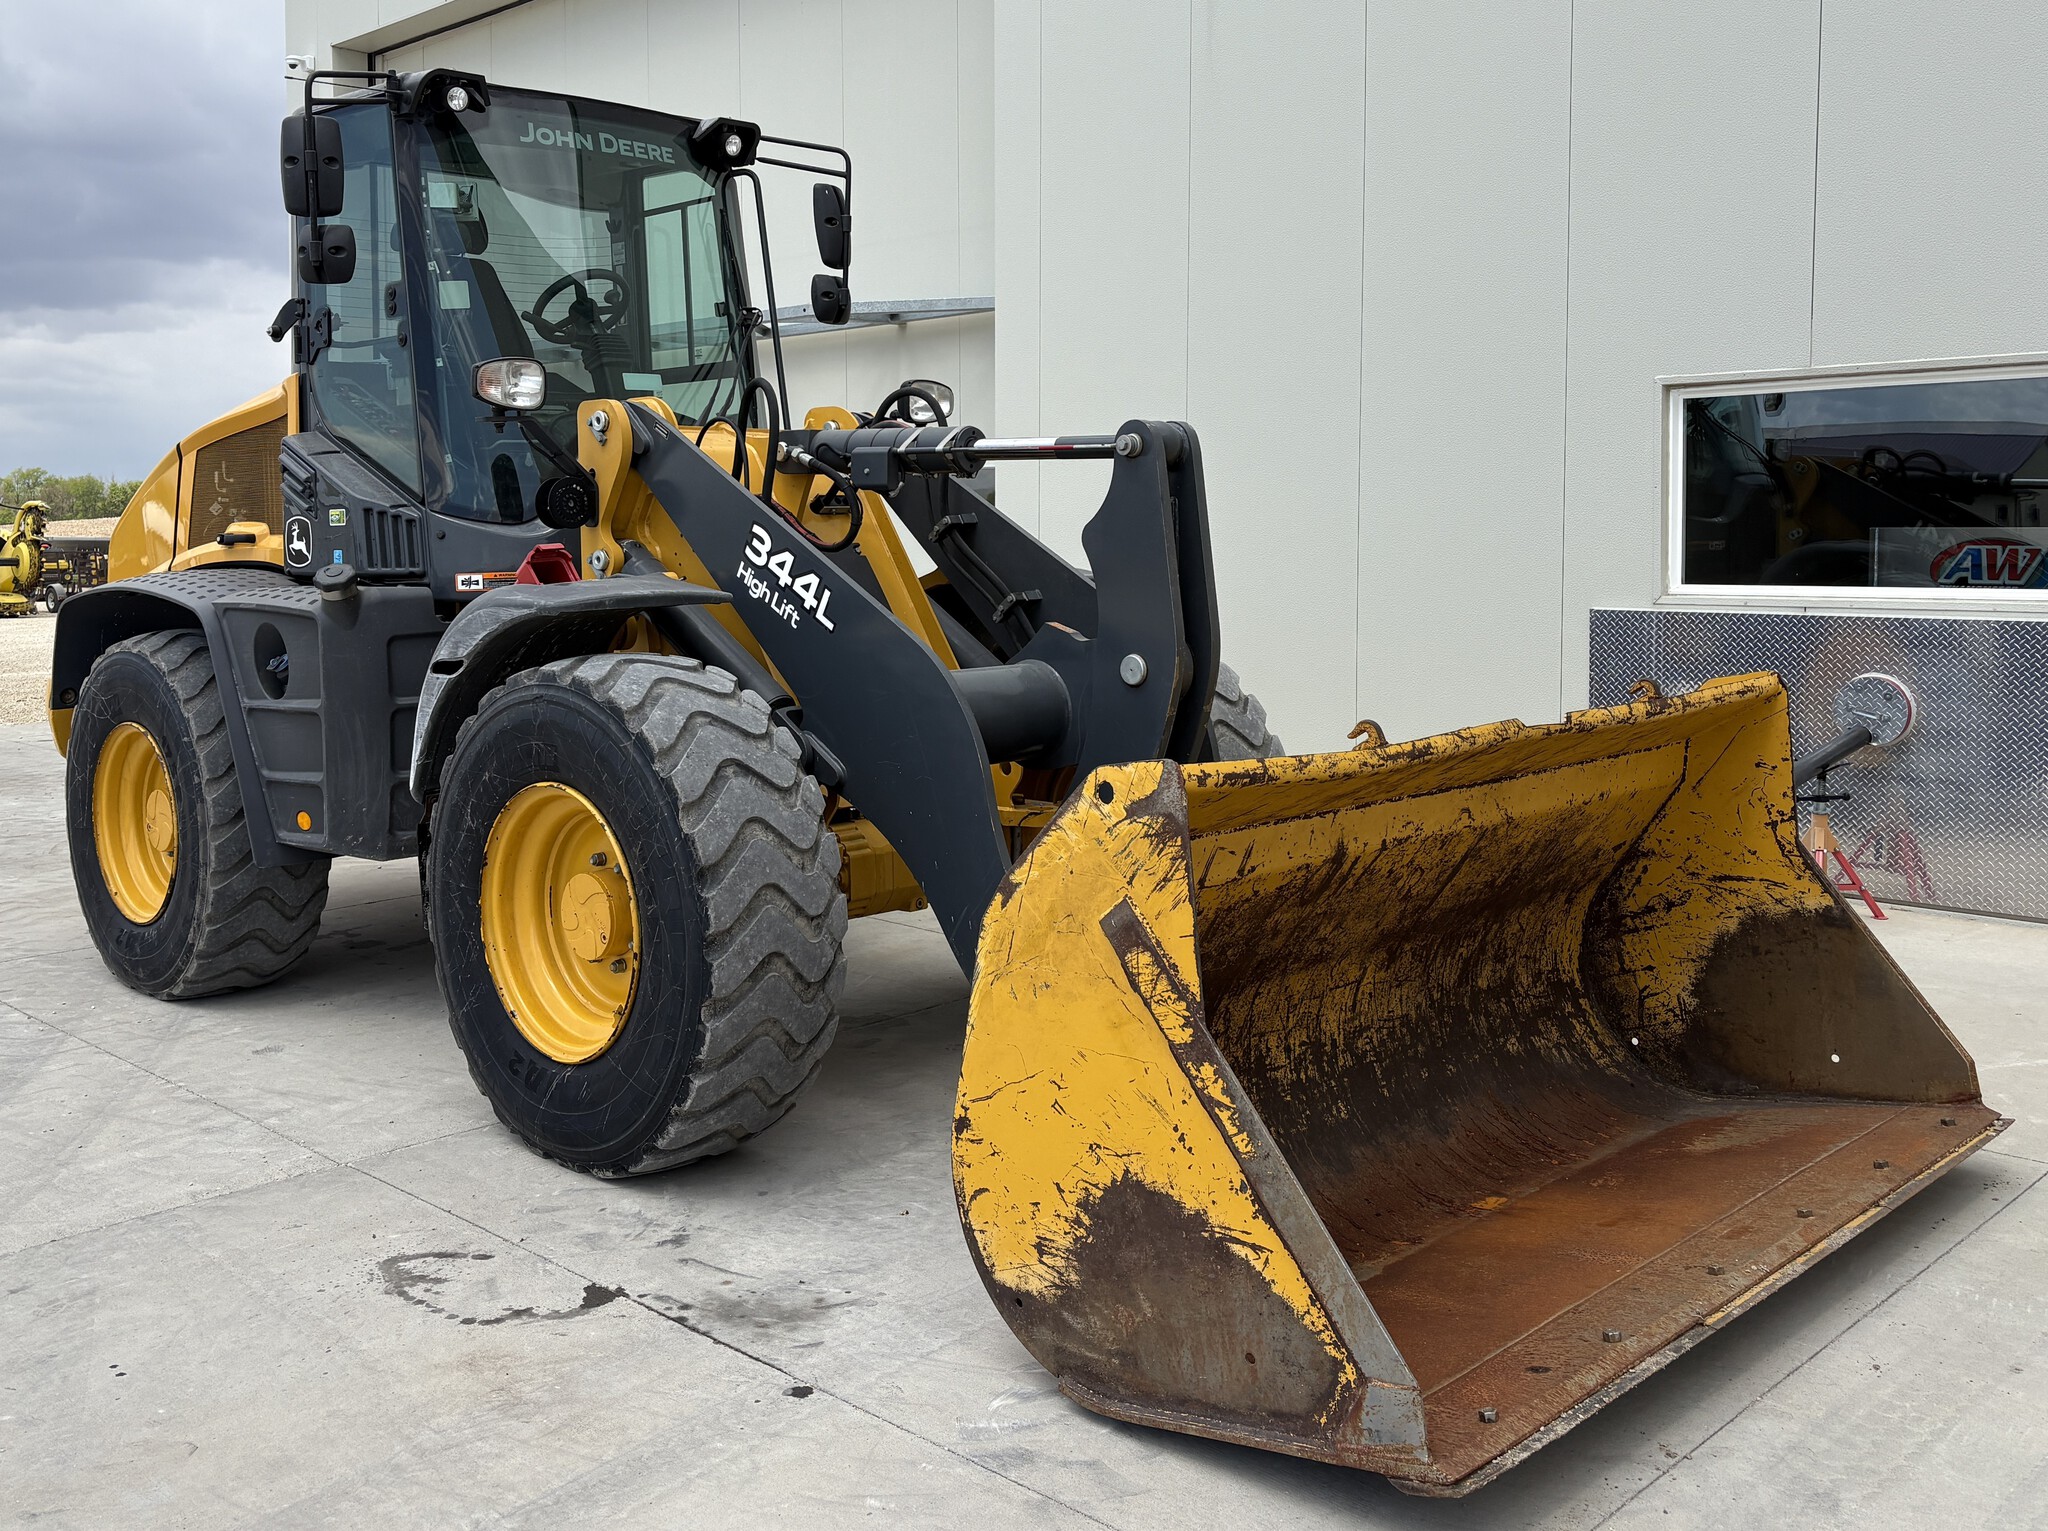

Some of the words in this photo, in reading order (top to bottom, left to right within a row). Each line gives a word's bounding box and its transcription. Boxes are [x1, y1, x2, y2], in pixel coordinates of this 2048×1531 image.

[520, 122, 594, 151] JOHN
[599, 132, 675, 164] DEERE
[744, 524, 835, 631] 344L
[1938, 545, 2045, 585] AW
[736, 560, 771, 603] High
[770, 591, 800, 629] Lift
